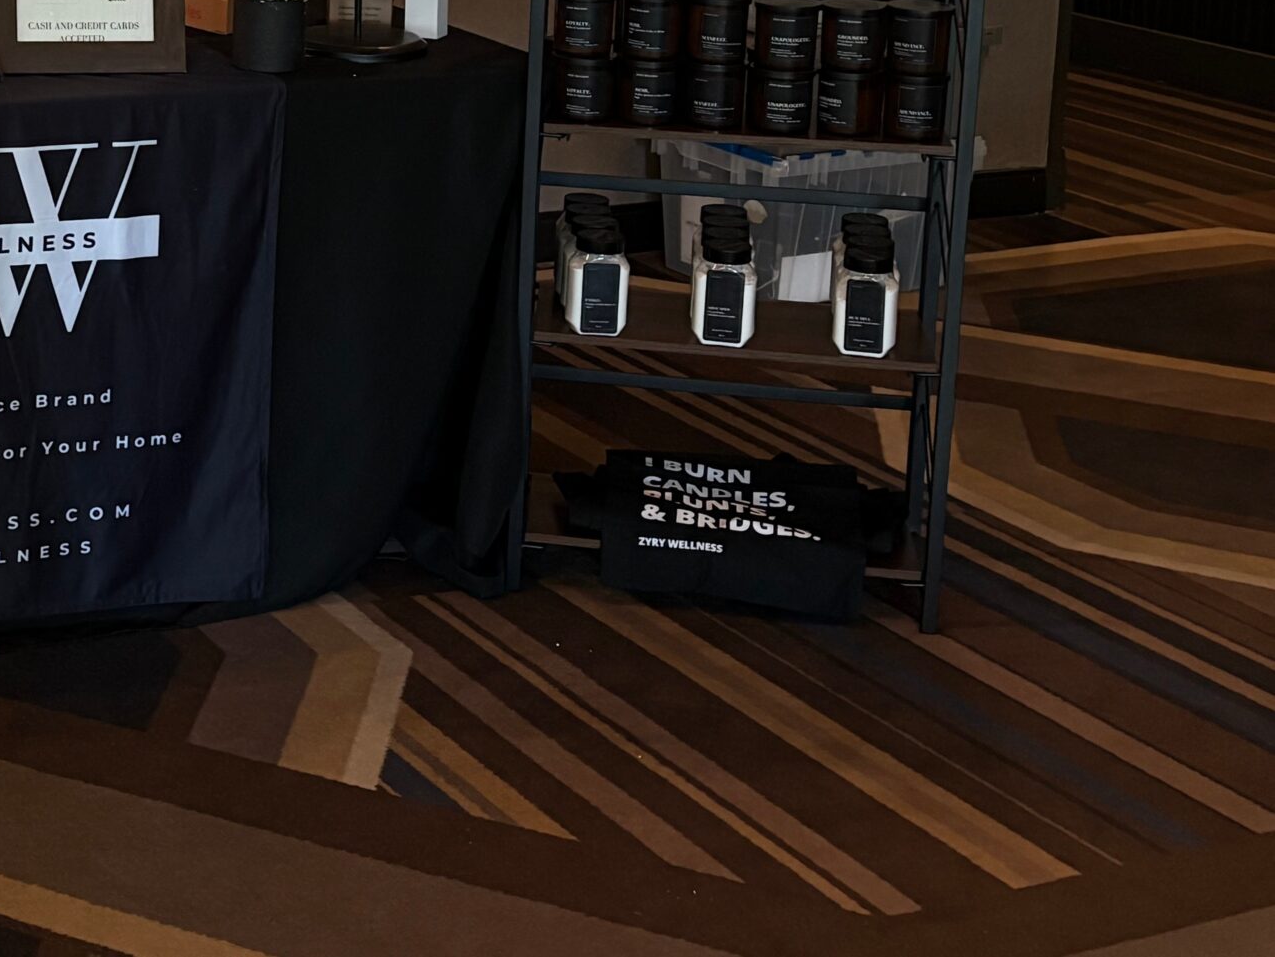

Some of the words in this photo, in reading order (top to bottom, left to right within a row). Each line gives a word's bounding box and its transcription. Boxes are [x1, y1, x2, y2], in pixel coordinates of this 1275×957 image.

[28, 22, 52, 30] CASH
[55, 22, 73, 30] AND
[75, 22, 107, 30] CREDIT
[110, 22, 140, 30] CARDS
[35, 389, 112, 408] Brand
[41, 438, 101, 455] Your
[115, 431, 183, 449] Home
[663, 459, 751, 485] BURN
[641, 503, 666, 522] &
[638, 536, 666, 548] ZYRY
[667, 539, 723, 554] WELLNESS
